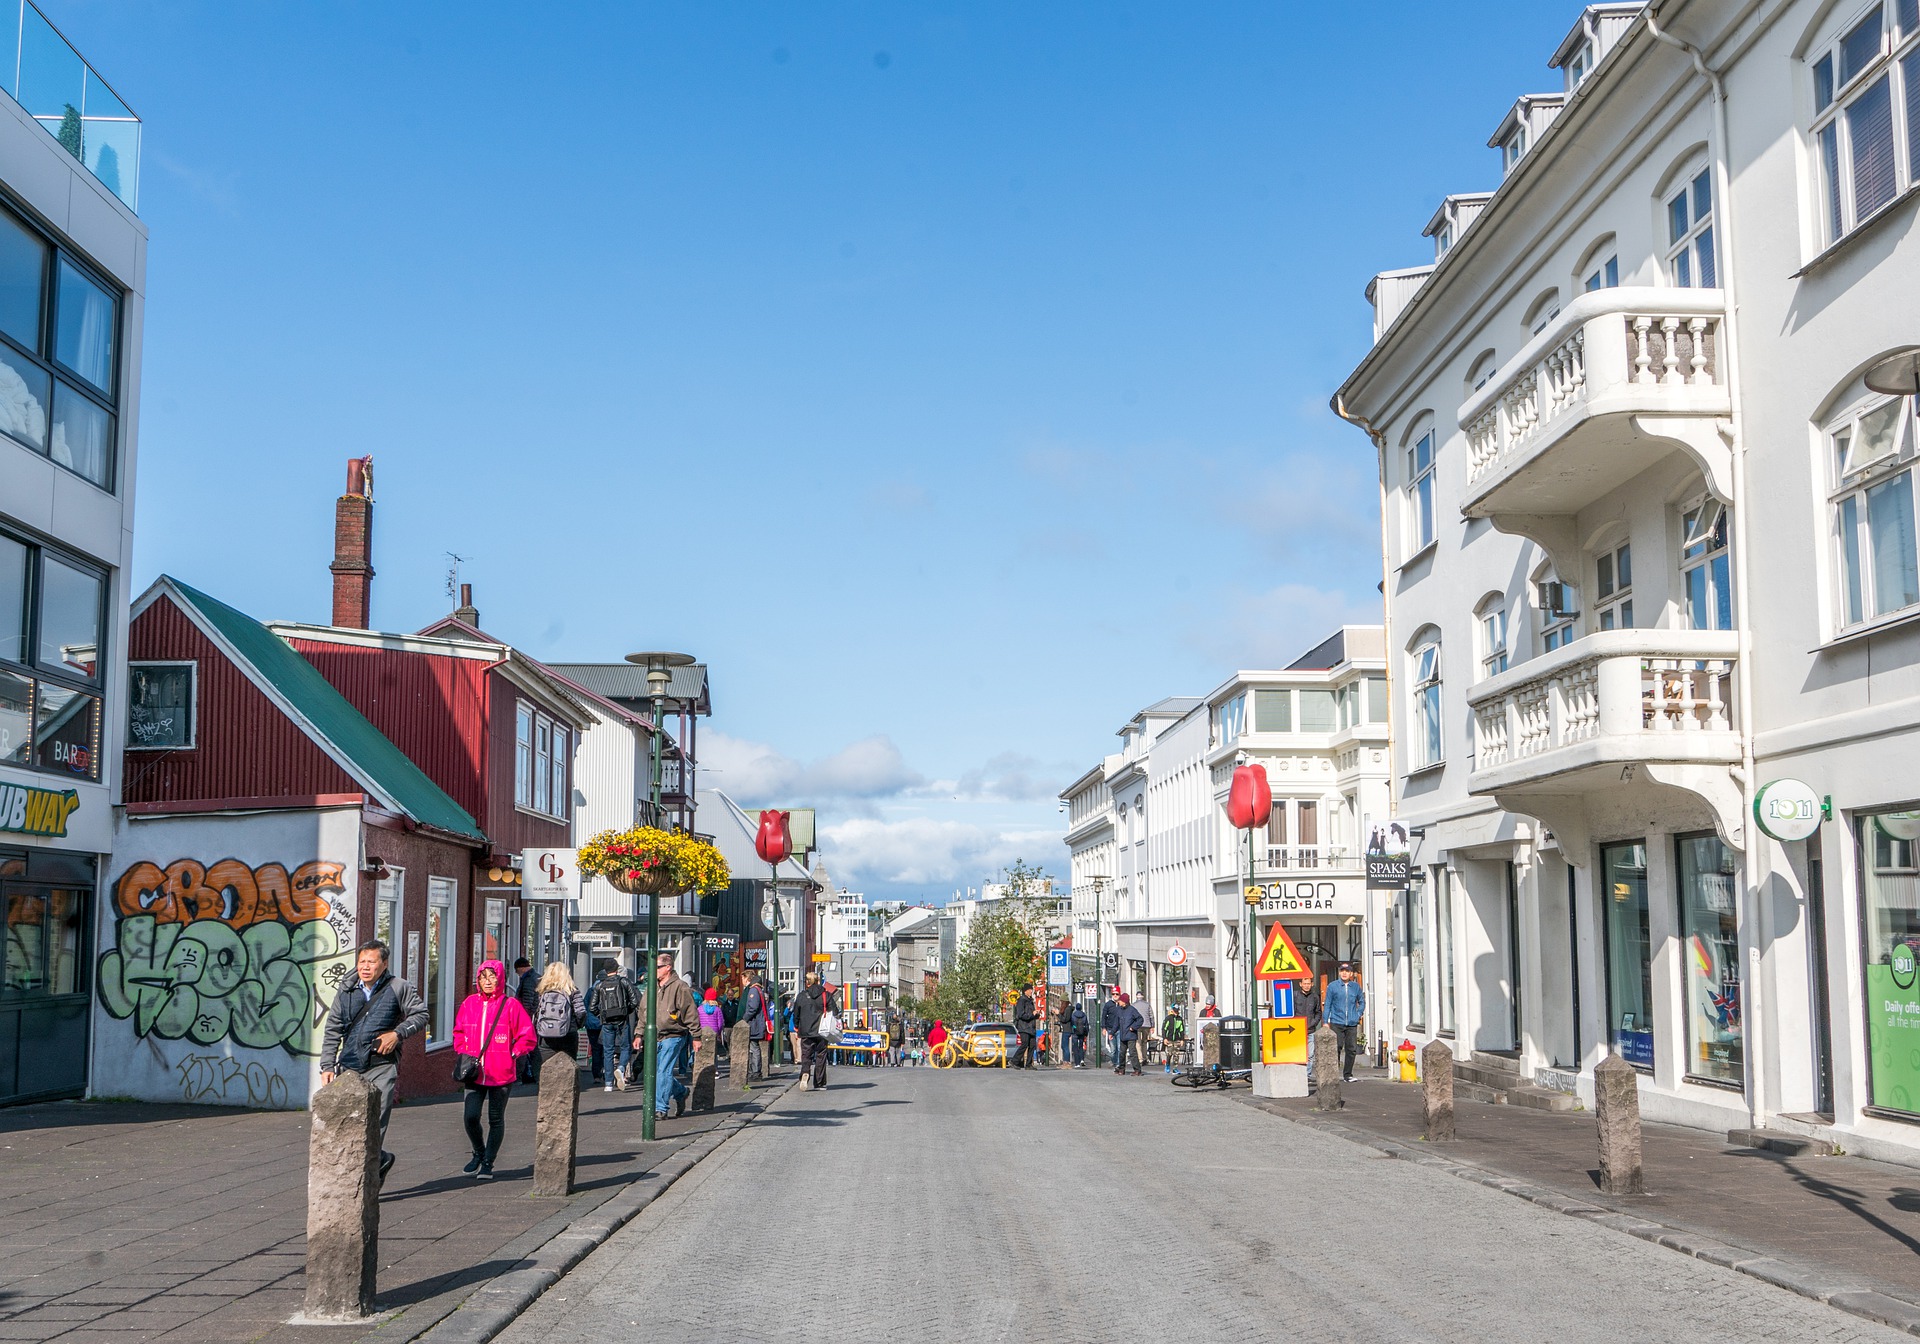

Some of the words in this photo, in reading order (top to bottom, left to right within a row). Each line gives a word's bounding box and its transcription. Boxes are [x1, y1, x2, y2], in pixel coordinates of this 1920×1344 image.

[55, 741, 78, 764] BAR
[0, 785, 79, 834] UBWAY
[1369, 862, 1407, 874] SPAKS
[1884, 1000, 1904, 1015] Daily
[1887, 1015, 1896, 1027] all
[1896, 1016, 1909, 1028] the
